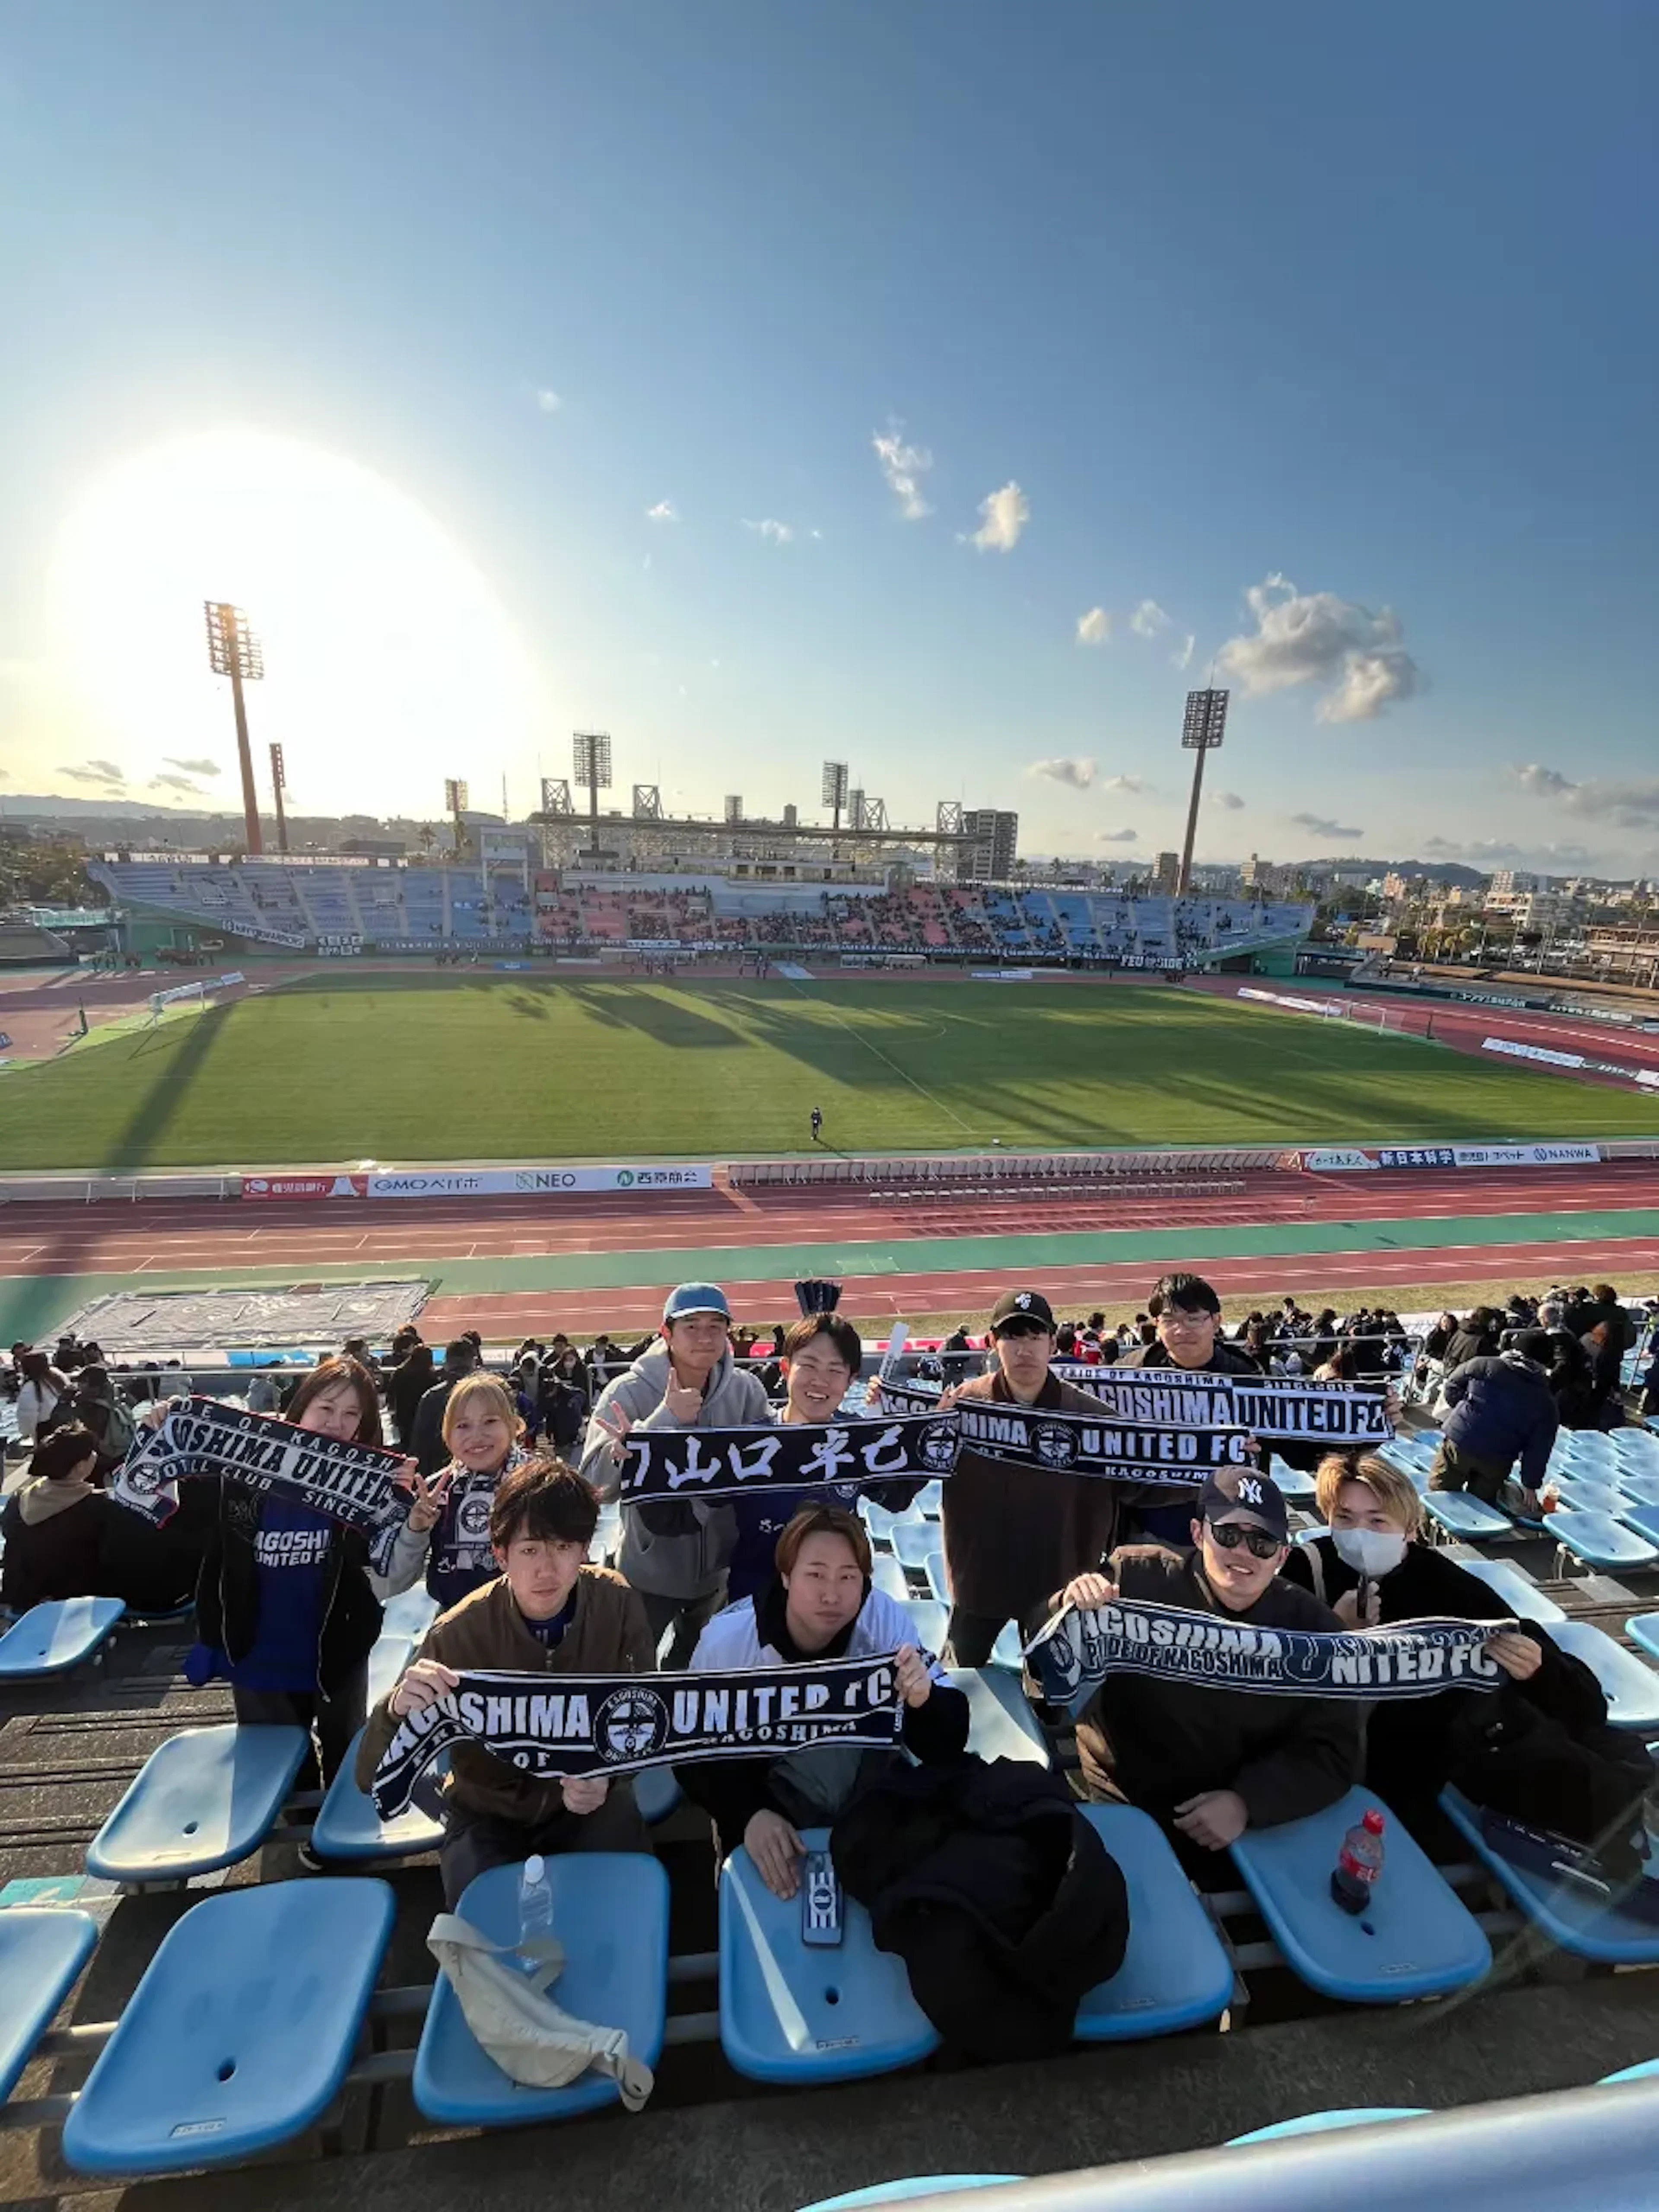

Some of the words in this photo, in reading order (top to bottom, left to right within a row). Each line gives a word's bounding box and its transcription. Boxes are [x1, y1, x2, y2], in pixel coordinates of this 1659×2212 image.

[1381, 1150, 1452, 1166] 新日本科学
[1549, 1148, 1593, 1159] NANWA
[536, 1173, 575, 1187] NEO
[238, 1416, 272, 1433] OF
[1239, 1395, 1346, 1433] UNITED
[1082, 1429, 1198, 1461] UNITED
[1210, 1434, 1246, 1463] FC
[1237, 1477, 1264, 1505] NY
[302, 1490, 359, 1522] SINCE
[1449, 1642, 1498, 1677] FC
[514, 1751, 551, 1769] OF
